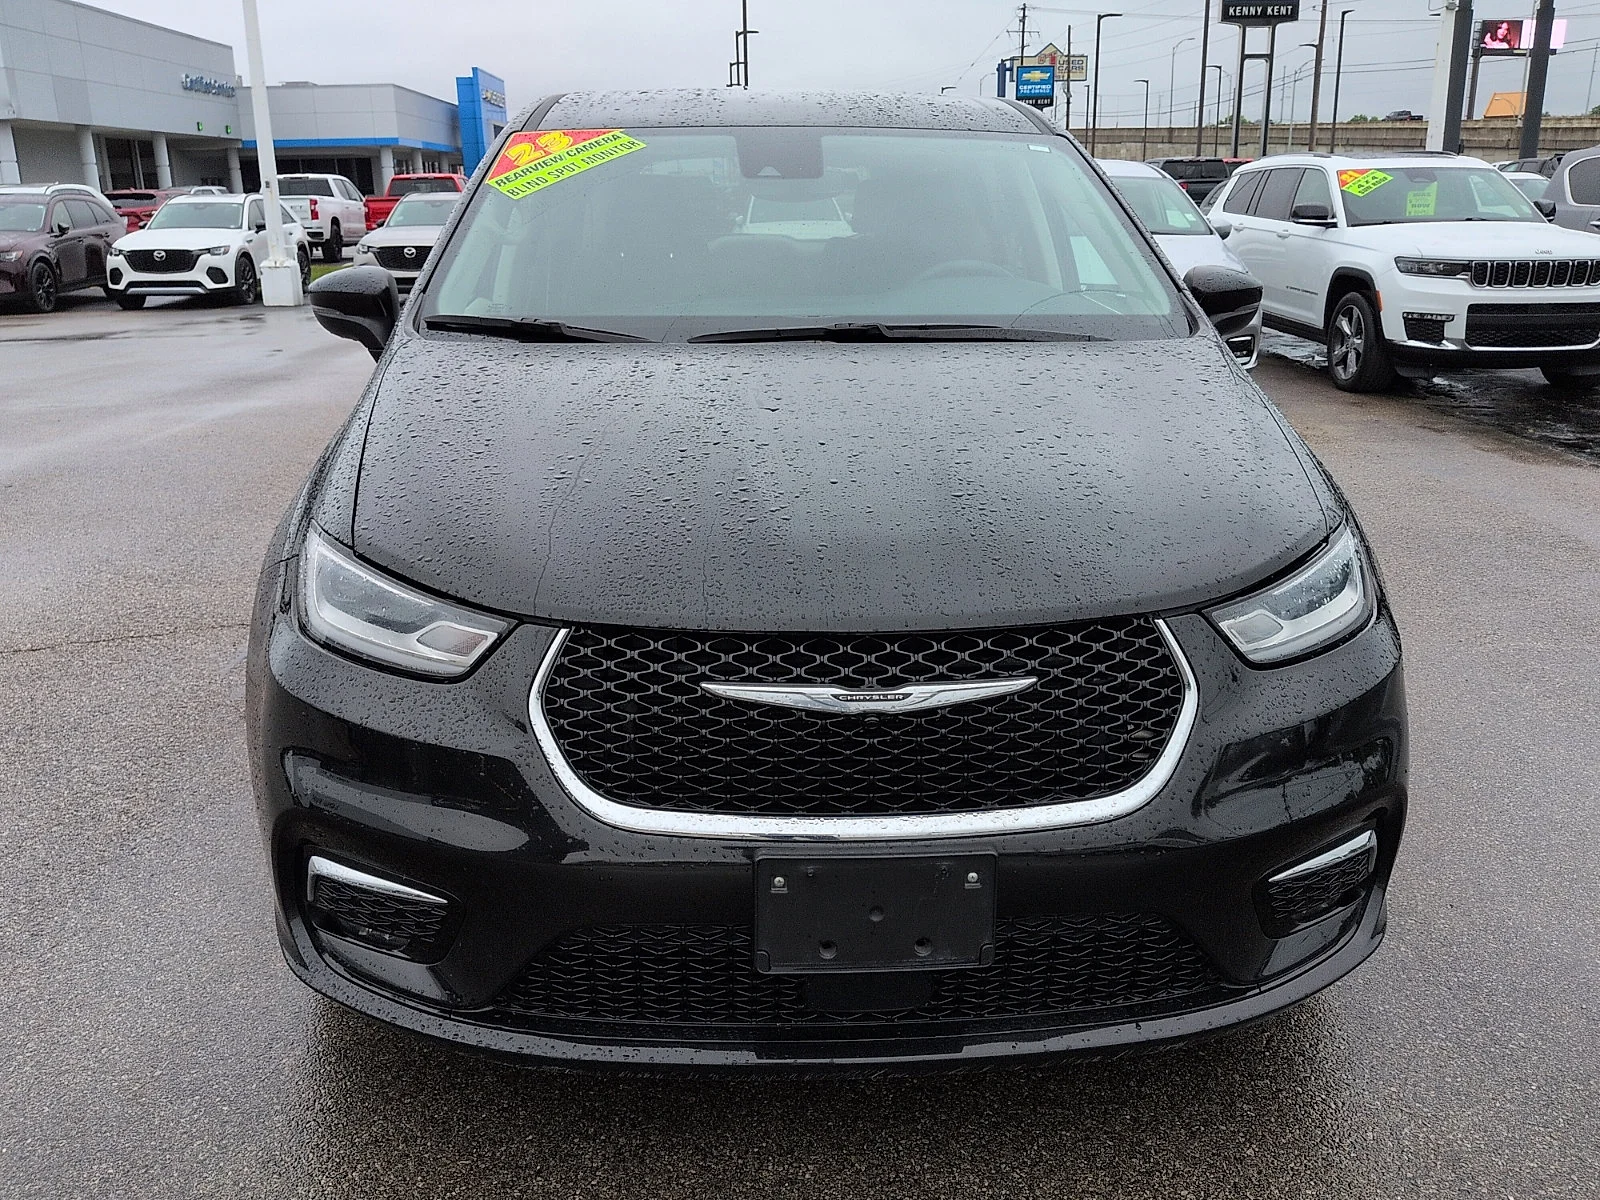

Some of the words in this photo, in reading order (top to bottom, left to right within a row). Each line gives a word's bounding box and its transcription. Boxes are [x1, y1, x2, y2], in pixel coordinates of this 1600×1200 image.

[1228, 6, 1262, 16] KENNY
[1267, 6, 1293, 16] KENT
[495, 154, 564, 187] REARVIEW
[566, 133, 622, 157] CAMERA
[504, 131, 573, 167] 23
[506, 176, 549, 197] BLIND
[547, 162, 582, 179] SPOT
[580, 140, 641, 166] MONITOR
